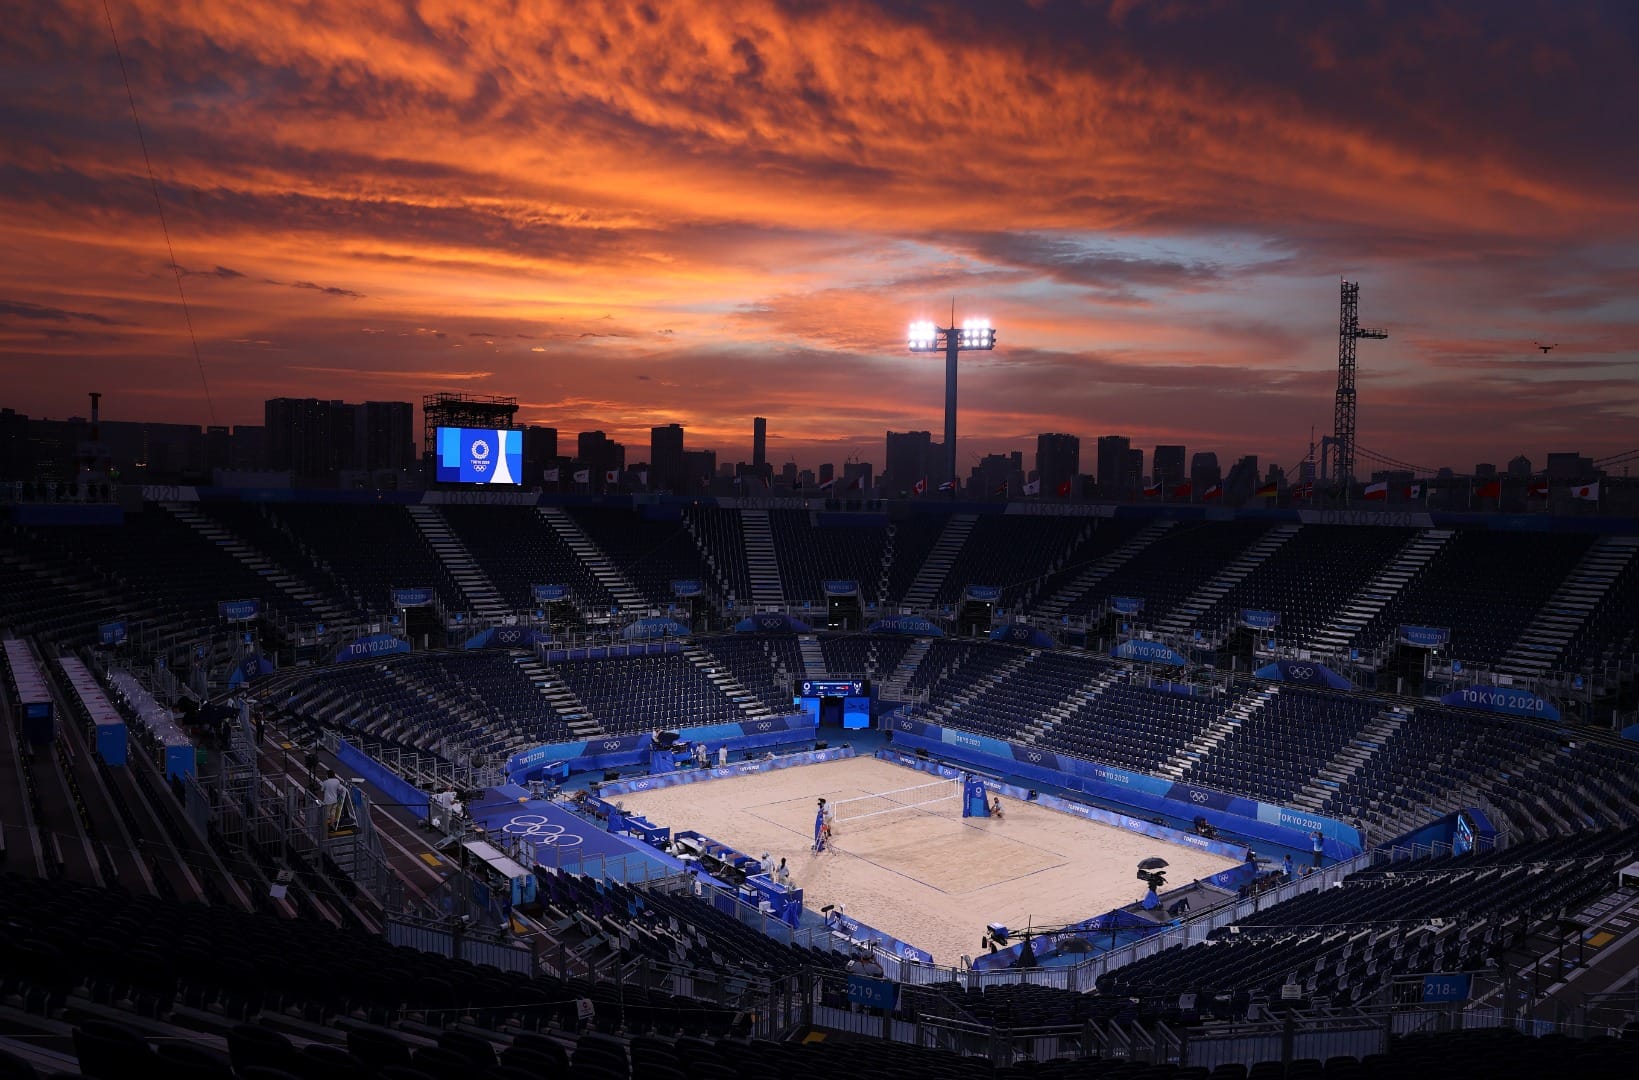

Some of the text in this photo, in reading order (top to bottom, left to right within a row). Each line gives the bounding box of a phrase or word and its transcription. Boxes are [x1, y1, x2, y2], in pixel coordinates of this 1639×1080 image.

[143, 486, 180, 500] 2020
[1319, 510, 1412, 526] TOKYO 2020
[632, 623, 657, 633] OKYO
[881, 619, 930, 631] TOKYO 2020
[350, 638, 398, 655] TOKYO 2020
[1123, 645, 1172, 659] TOKYO 2020
[1462, 689, 1544, 711] TOKYO 2020
[954, 734, 969, 743] OKYO
[1094, 769, 1129, 784] TOKYO 2020
[1278, 813, 1322, 831] TOKYO 2020
[849, 983, 873, 999] 219
[1426, 983, 1450, 995] 218
